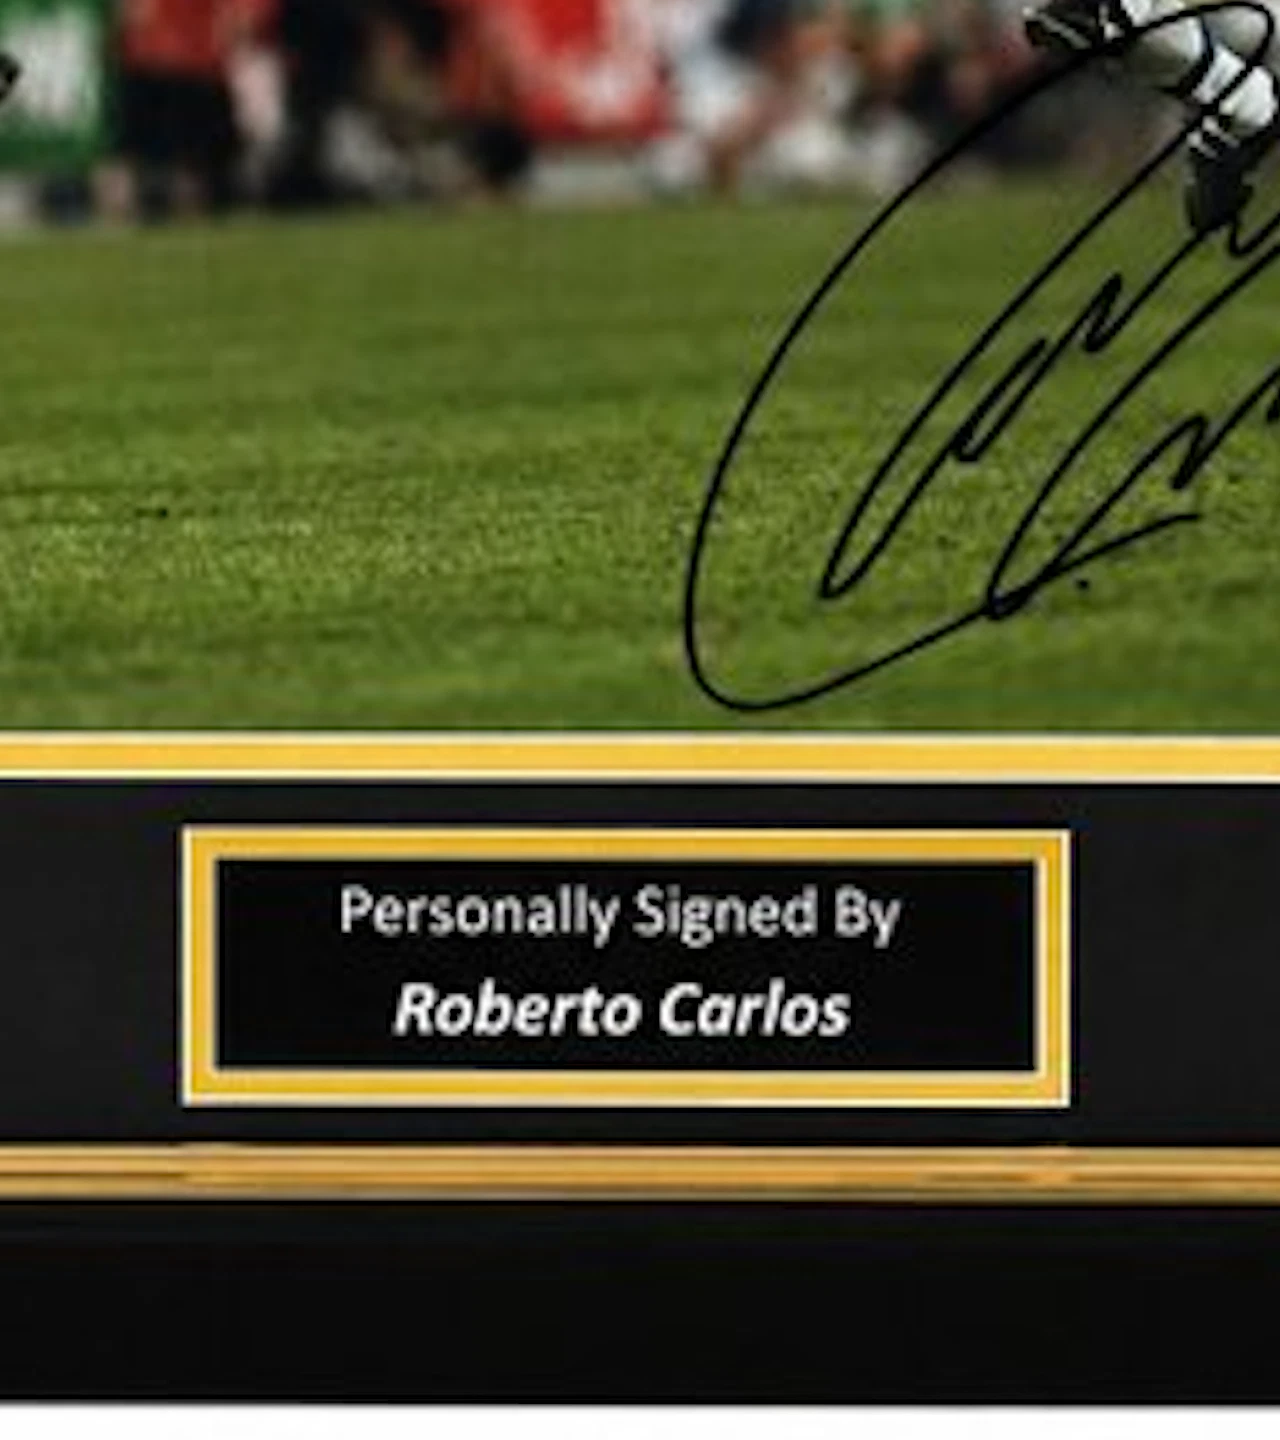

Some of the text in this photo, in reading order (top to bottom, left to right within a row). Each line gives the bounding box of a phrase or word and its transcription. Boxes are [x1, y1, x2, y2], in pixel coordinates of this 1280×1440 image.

[340, 884, 902, 948] Personally Signed By
[393, 977, 851, 1037] Roberto Carlos
